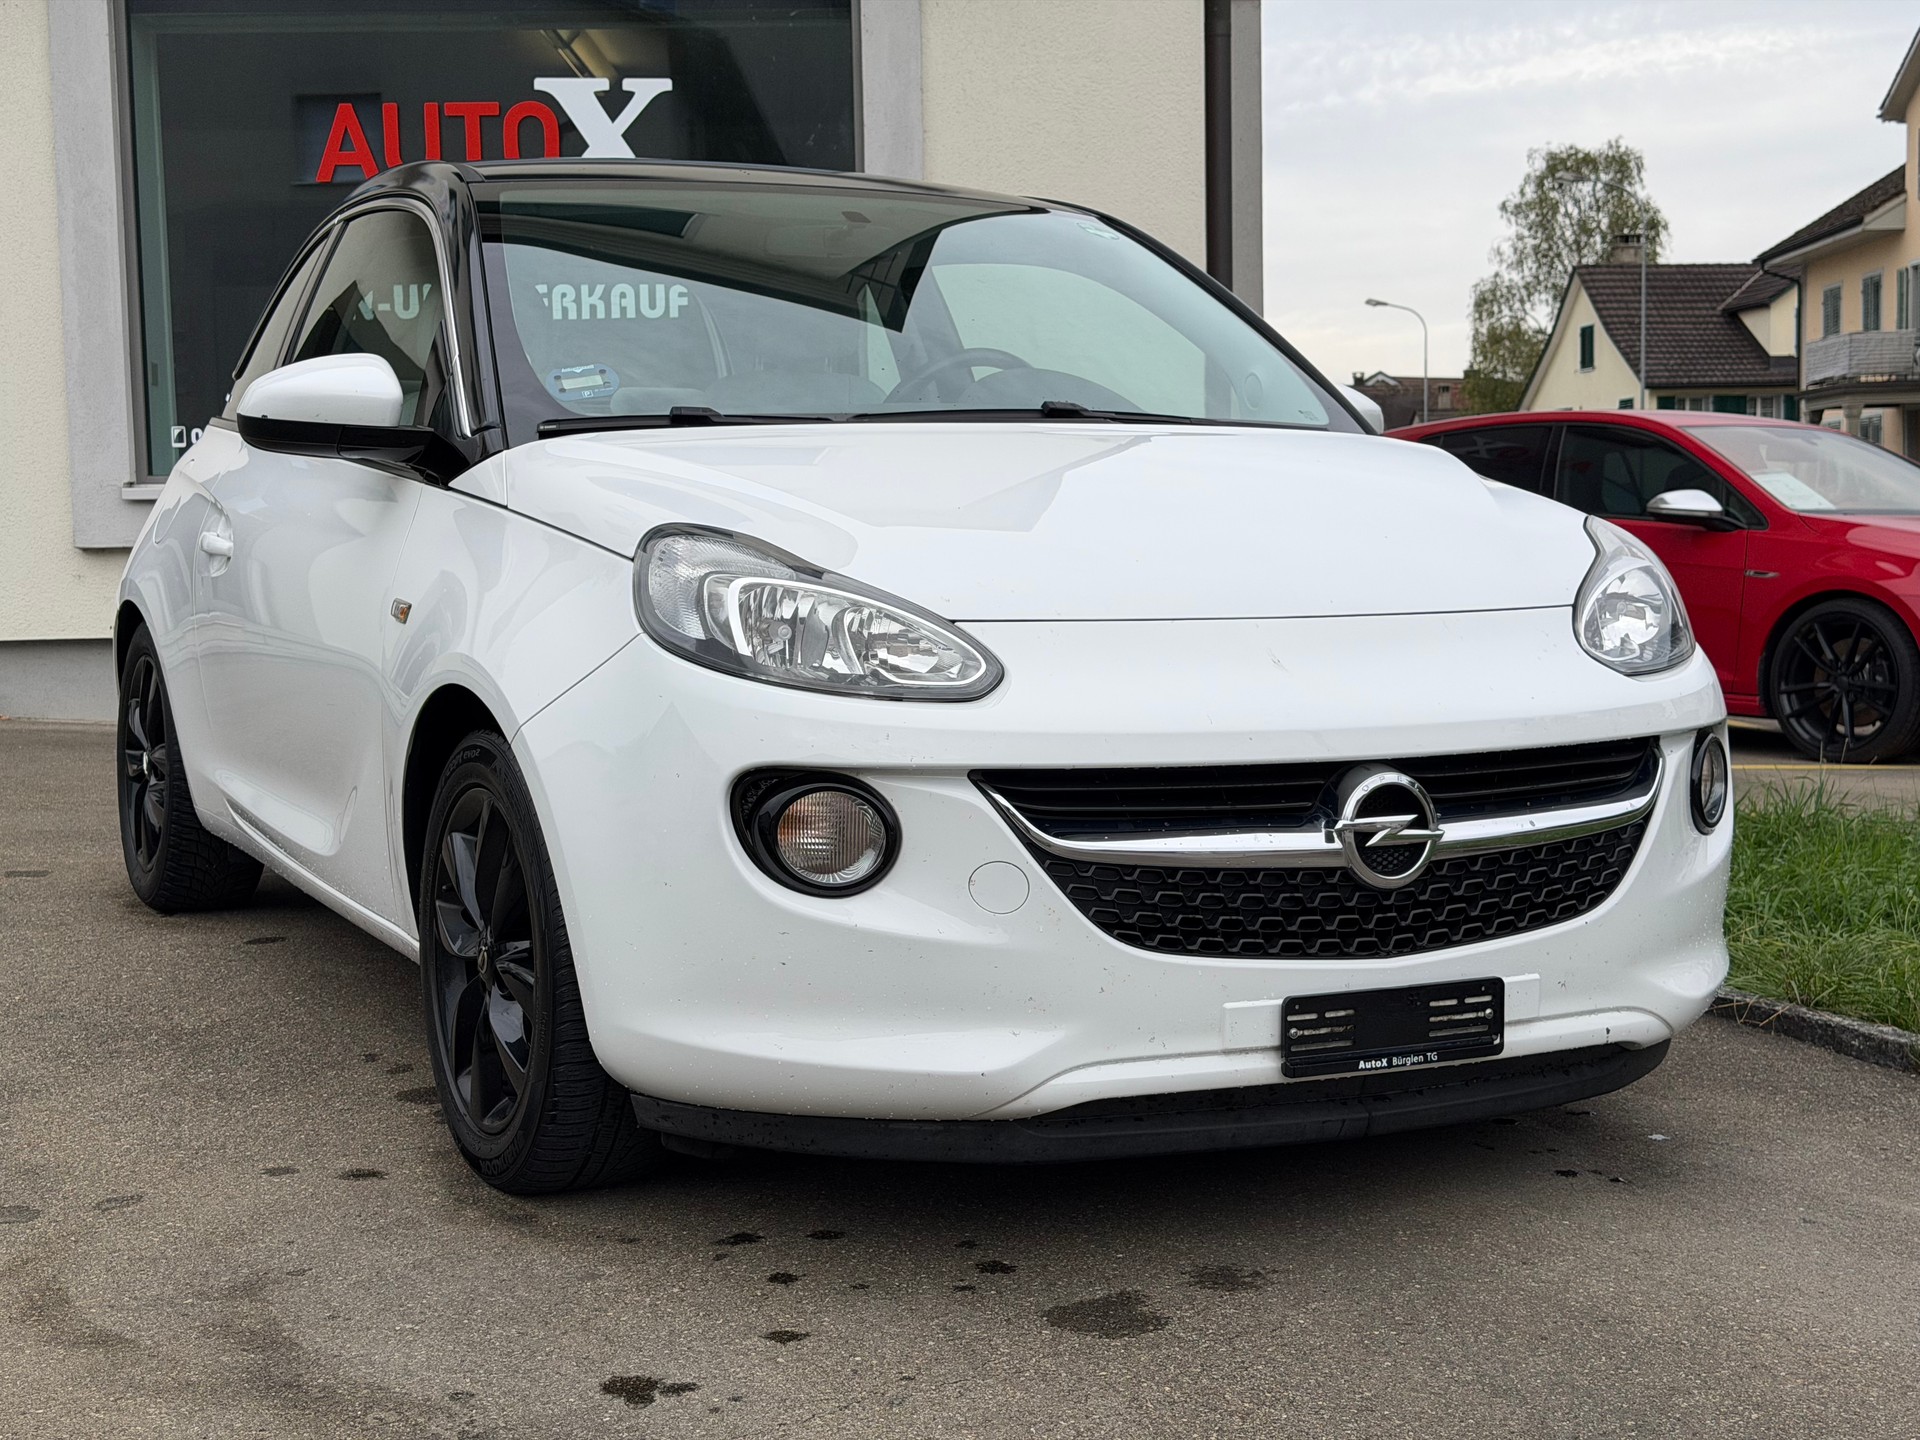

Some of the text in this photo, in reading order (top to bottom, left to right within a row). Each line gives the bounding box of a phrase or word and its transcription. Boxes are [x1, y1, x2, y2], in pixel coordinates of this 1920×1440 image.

[535, 283, 689, 320] RKAUF
[1362, 775, 1420, 792] OPEL
[1358, 1052, 1438, 1070] AutoX Bürglen TG
